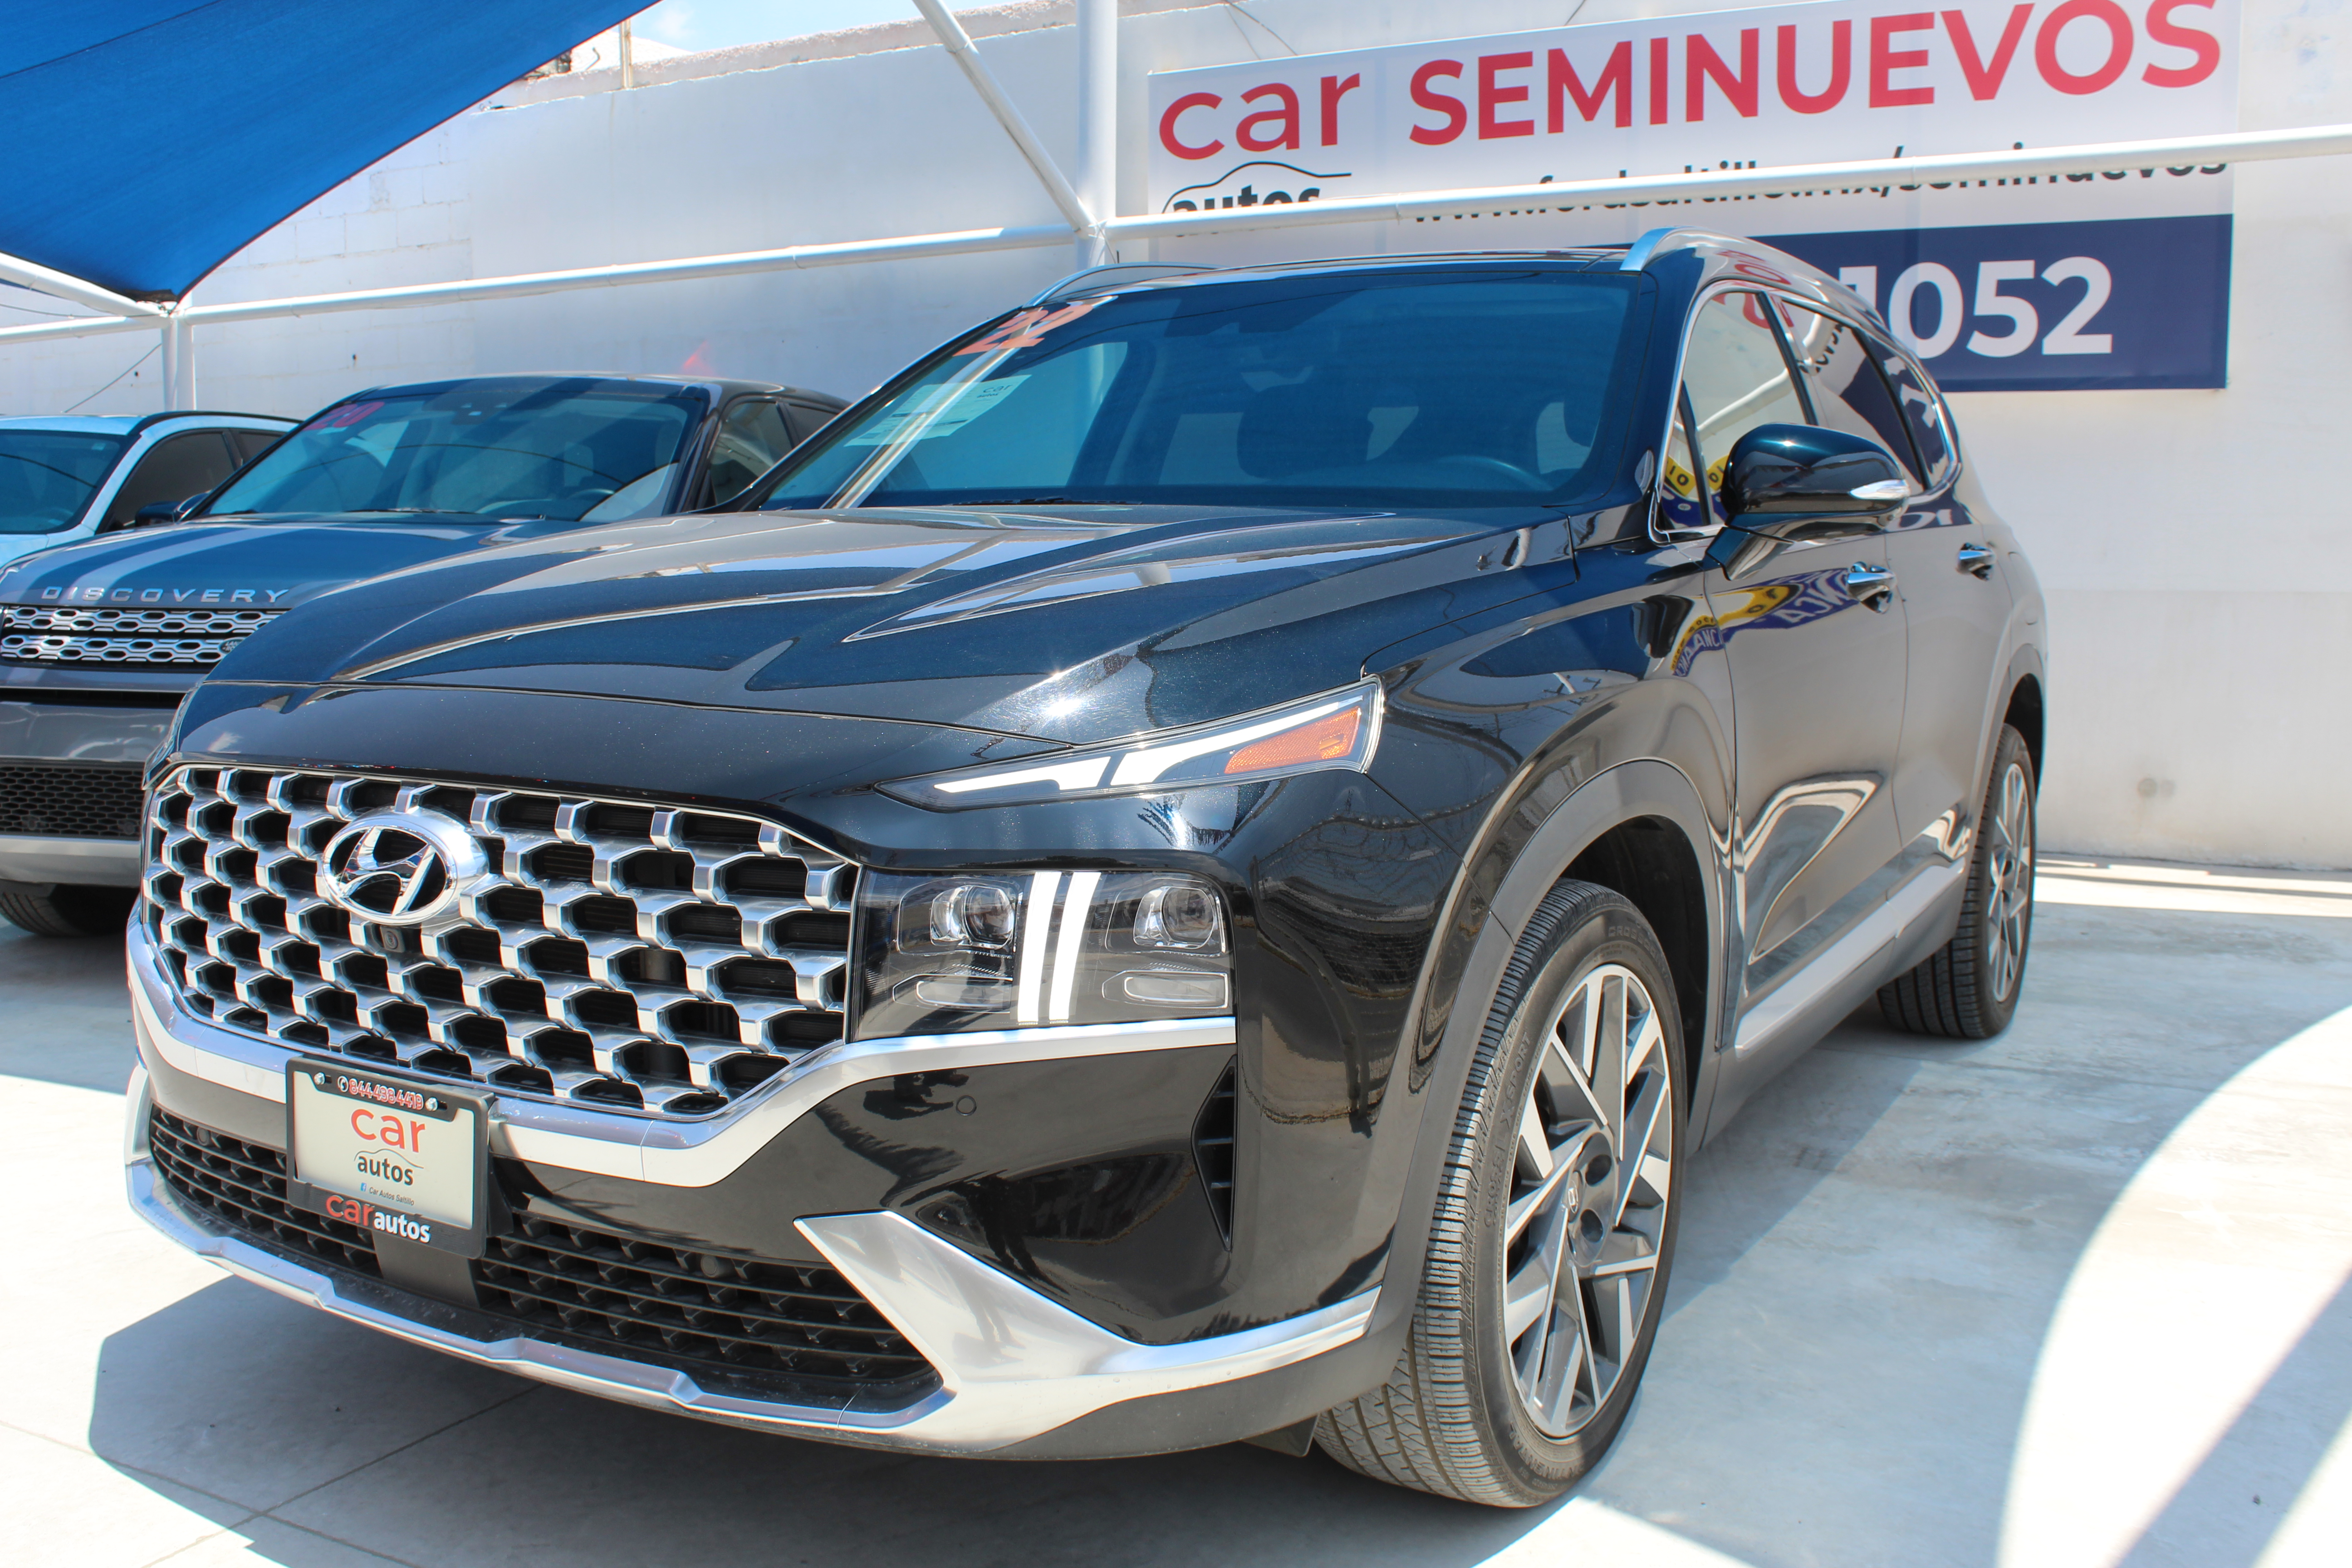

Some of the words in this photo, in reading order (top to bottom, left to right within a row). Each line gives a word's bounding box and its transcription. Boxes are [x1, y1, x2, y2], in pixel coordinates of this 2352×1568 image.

[1160, 74, 1360, 160] car
[1410, 0, 2220, 146] SEMINUEVOS
[41, 586, 289, 603] DISCOVERY
[351, 1108, 426, 1153] car
[357, 1156, 414, 1186] autos
[369, 1186, 379, 1195] Car
[379, 1190, 395, 1200] Autos
[396, 1194, 415, 1206] Saltillo
